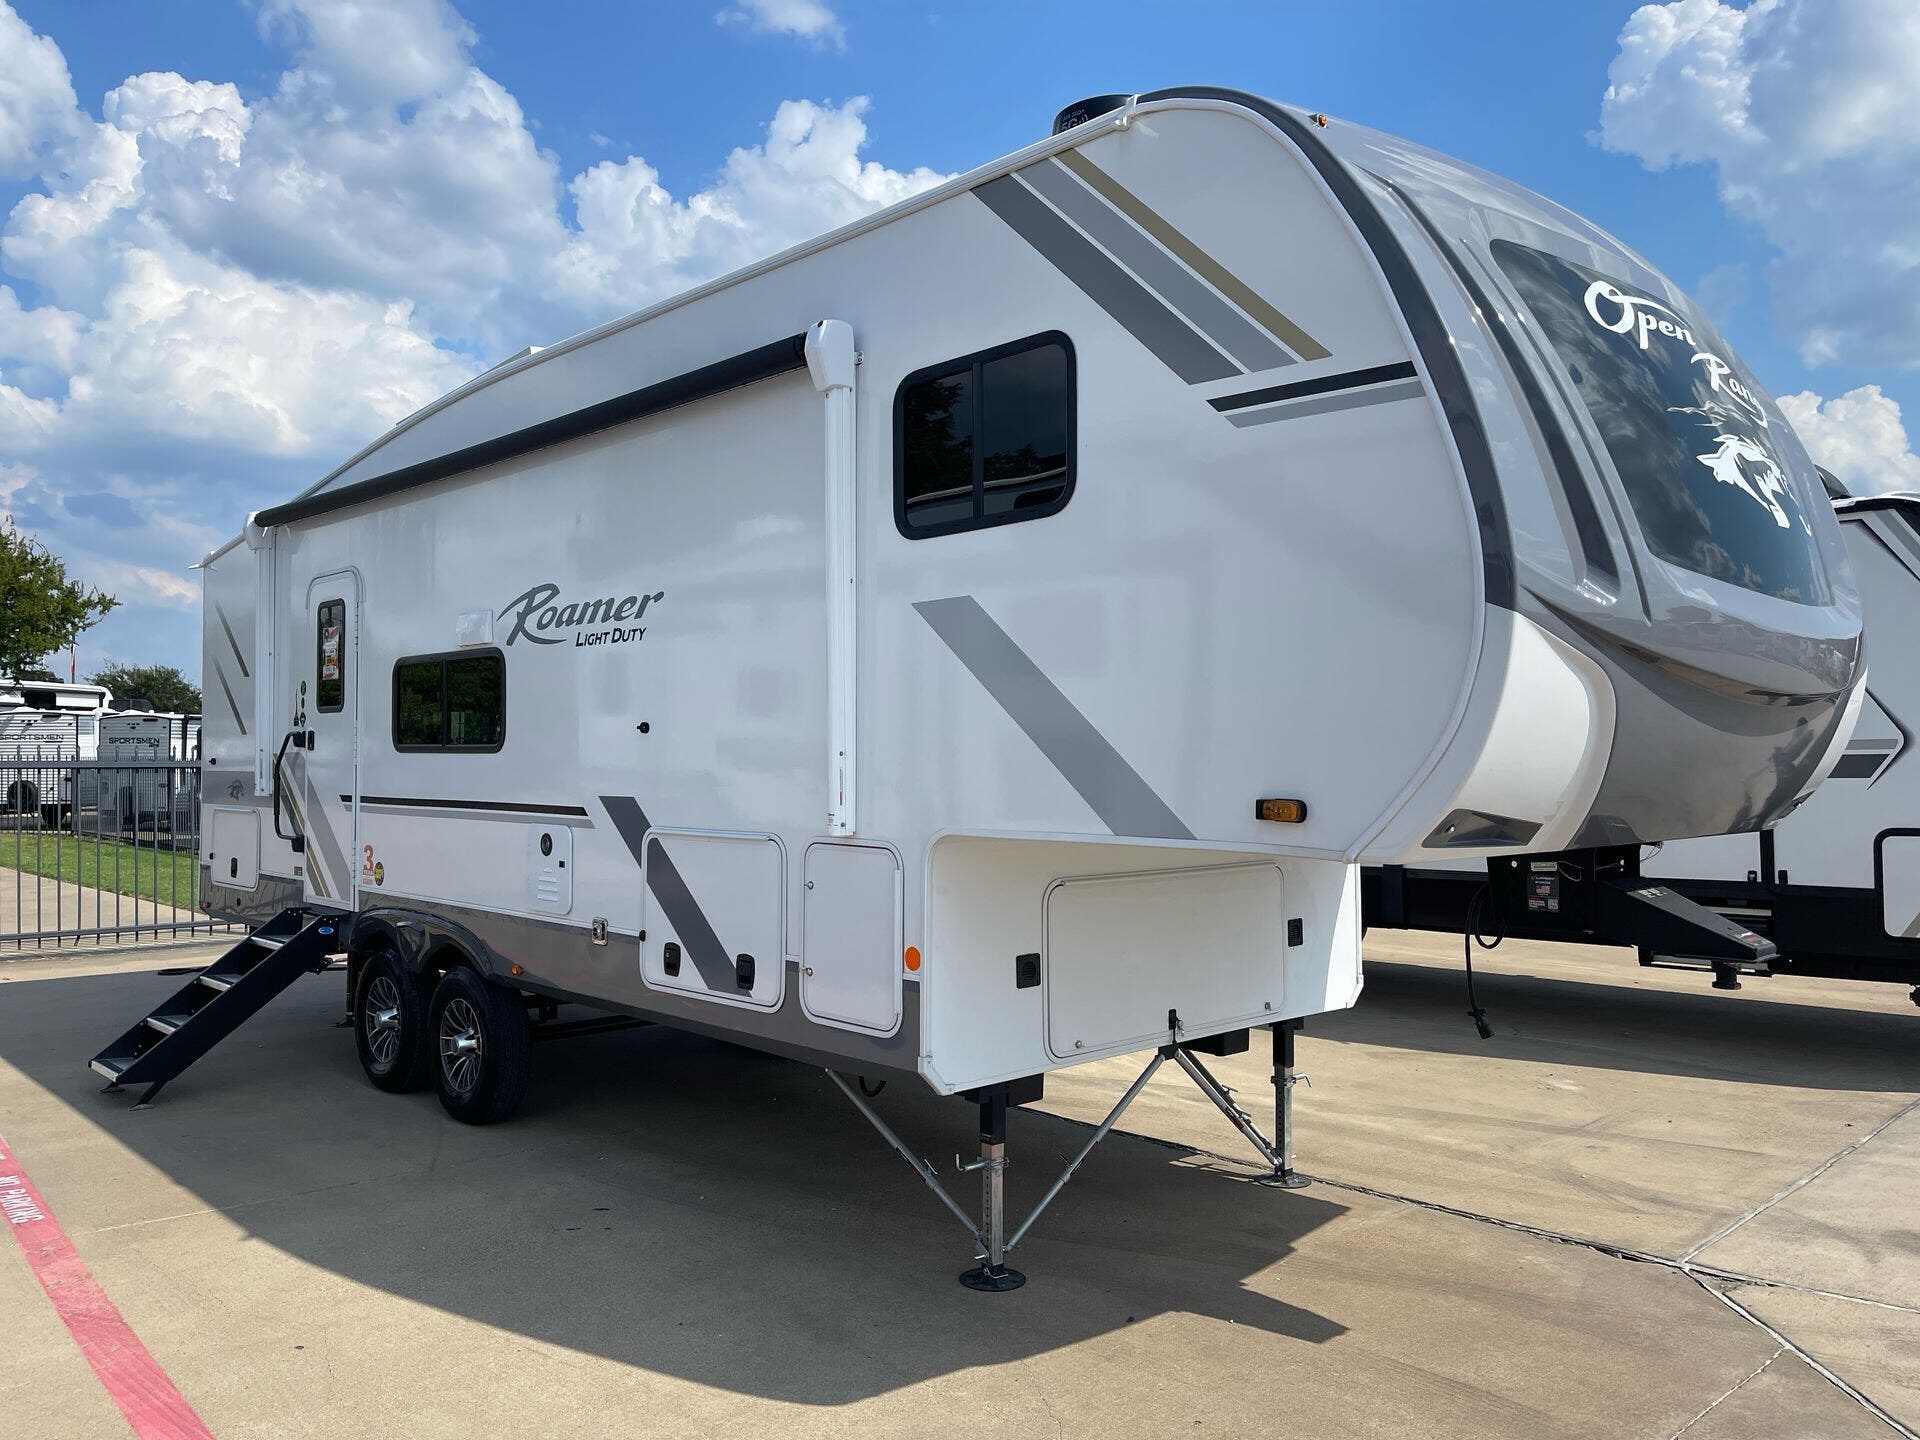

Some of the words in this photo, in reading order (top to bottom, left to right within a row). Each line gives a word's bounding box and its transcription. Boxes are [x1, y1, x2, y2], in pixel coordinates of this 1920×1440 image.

[1584, 280, 1697, 349] Open
[1690, 352, 1768, 428] Rang
[496, 583, 665, 646] Roamer
[575, 631, 610, 647] LIGHT
[611, 627, 648, 644] DUTY
[108, 736, 160, 745] SPORTSMEN
[0, 1188, 45, 1224] PARKING
